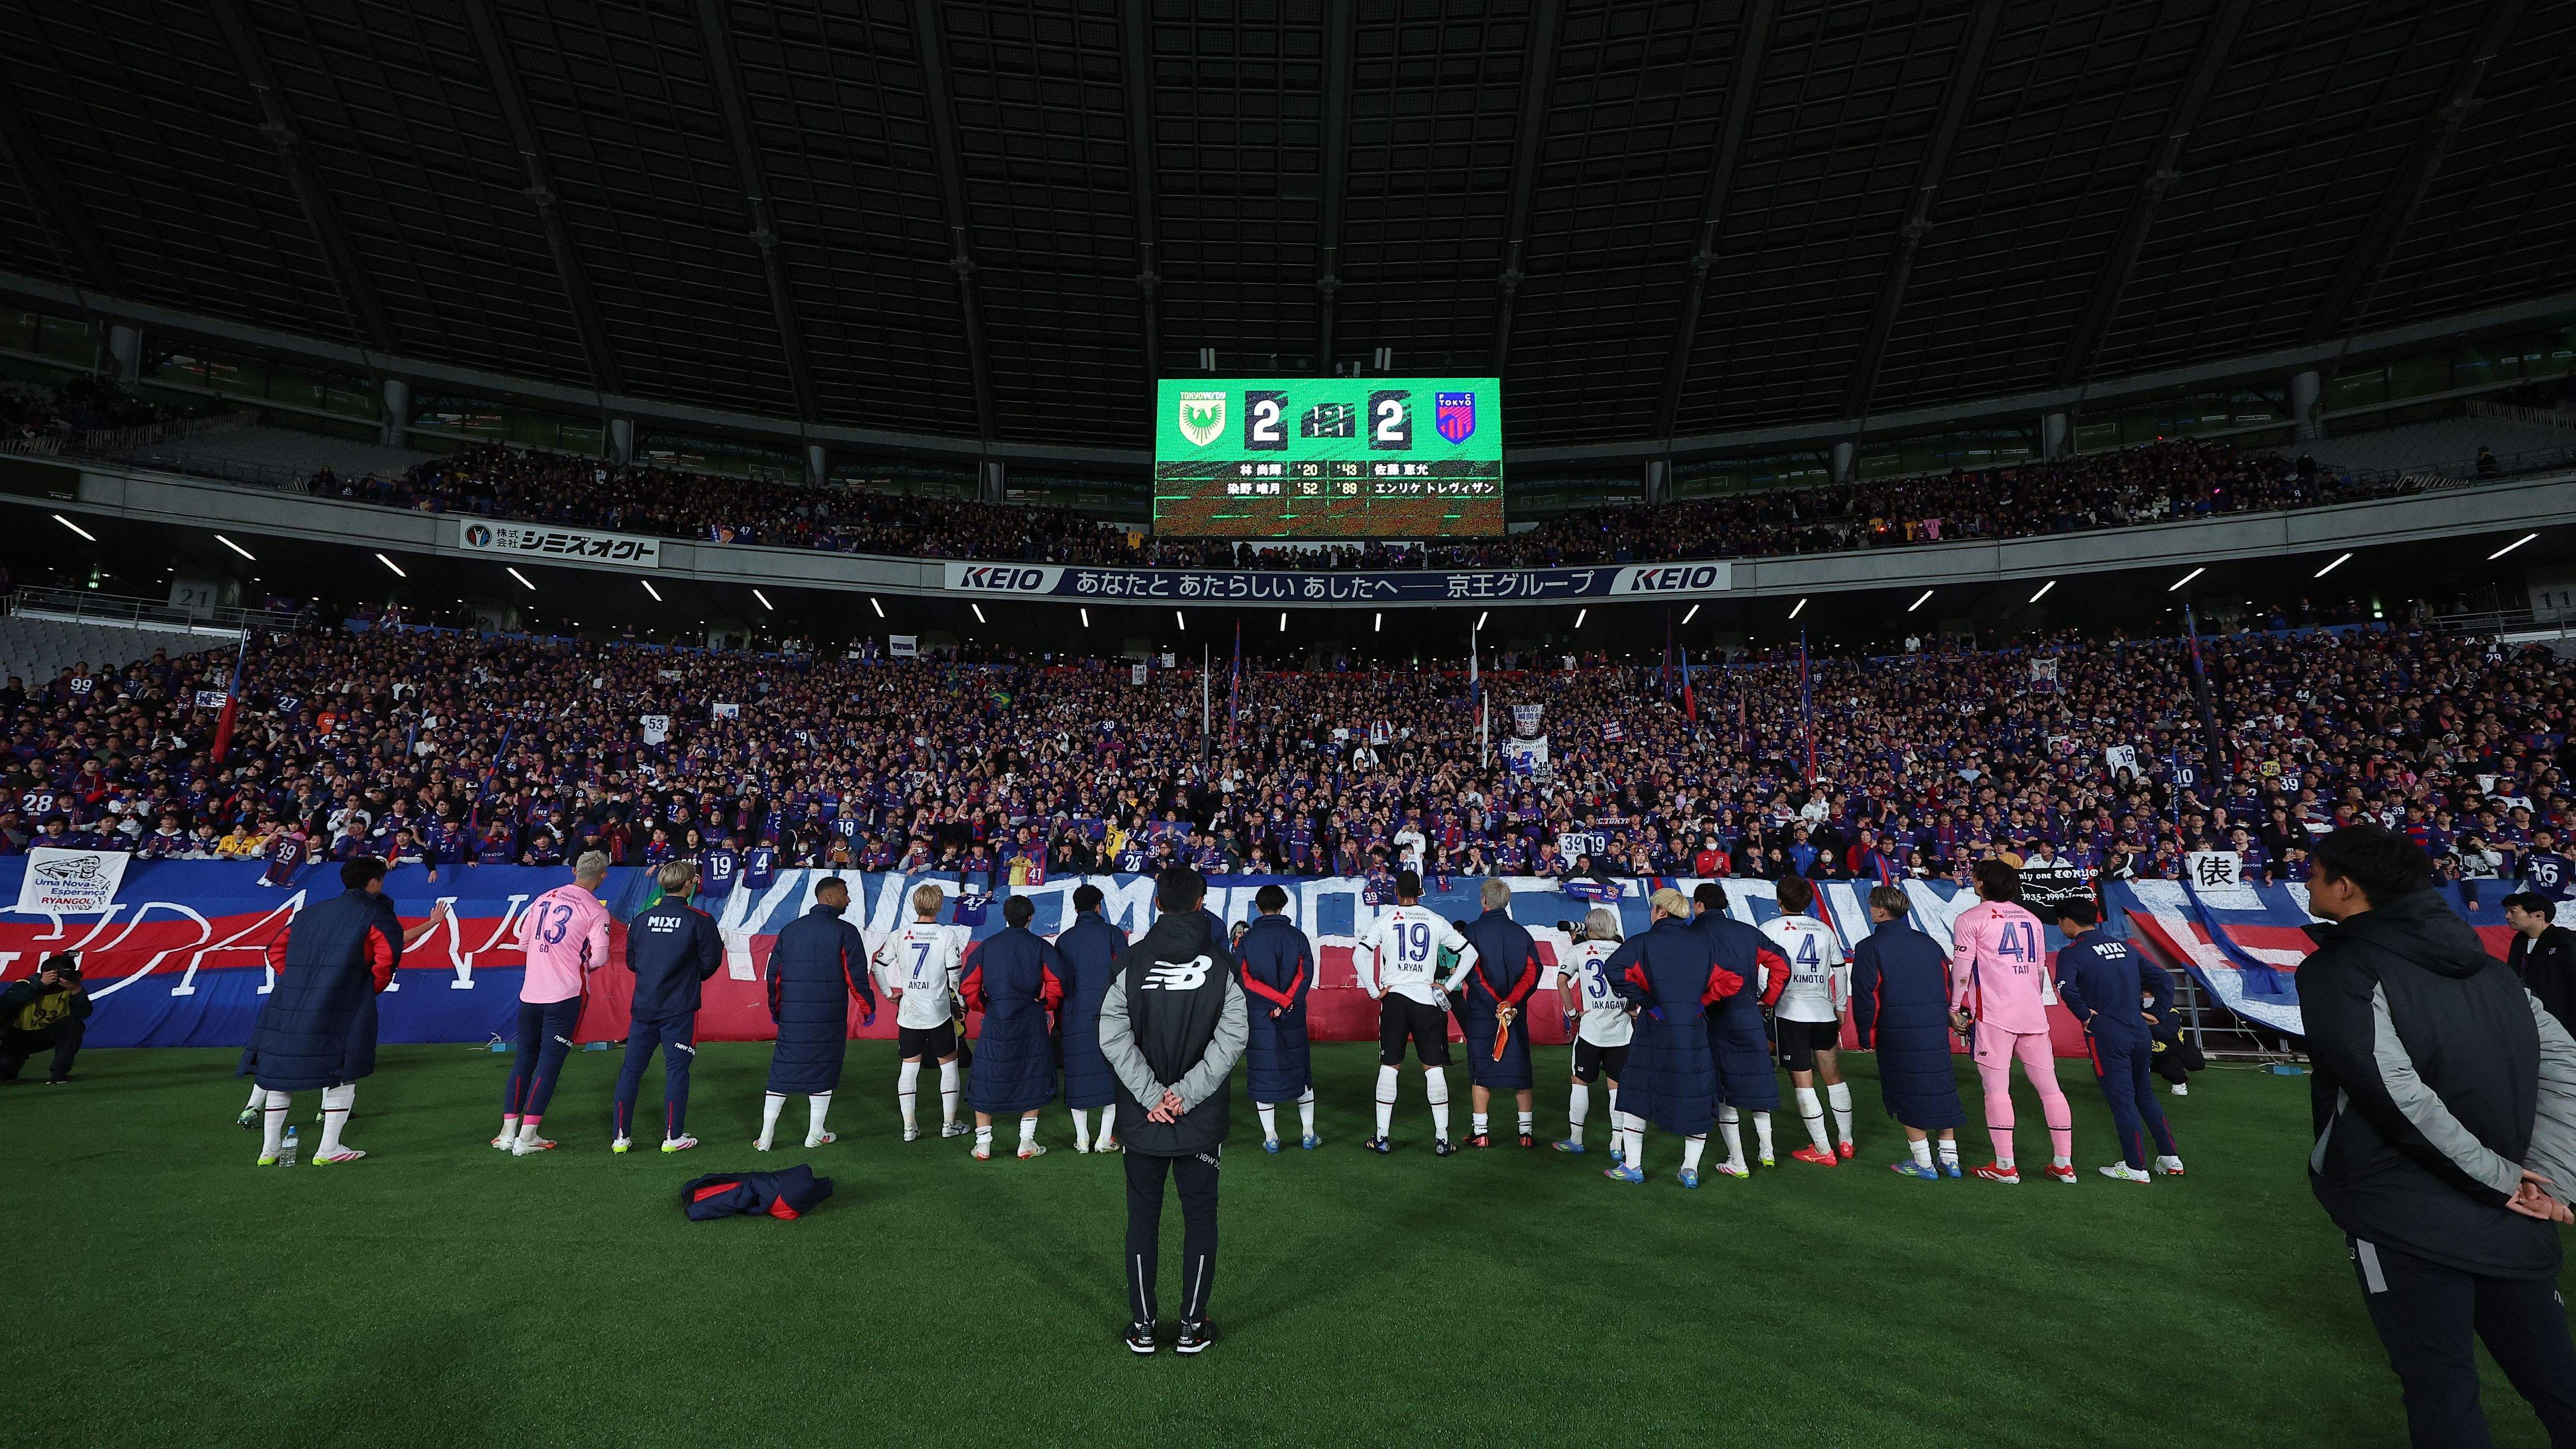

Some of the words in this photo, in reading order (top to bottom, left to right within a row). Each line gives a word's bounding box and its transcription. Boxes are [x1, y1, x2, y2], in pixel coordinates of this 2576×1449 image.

[1254, 399, 1280, 441] 2
[1378, 399, 1403, 441] 2
[1240, 464, 1252, 476] 林
[1257, 464, 1281, 476] 尚輝
[1374, 464, 1400, 476] 佐藤
[1404, 464, 1429, 476] 恵允
[1227, 482, 1252, 495] 染野
[1257, 482, 1280, 495] 唯月
[1375, 483, 1422, 495] エンリケ
[1426, 482, 1494, 495] トレヴィザン
[496, 528, 519, 538] 株式
[740, 526, 750, 535] 47
[496, 539, 518, 549] 会社
[520, 531, 655, 561] シミズオクト
[960, 567, 1043, 590] KEIO
[1076, 572, 1169, 595] あなたと
[1178, 574, 1295, 598] あたらしい
[1303, 576, 1399, 599] あしたへ
[1447, 570, 1595, 598] 京王グループ
[1631, 566, 1718, 590] KEIO
[180, 588, 207, 606] 21
[2540, 590, 2570, 609] 11
[69, 677, 93, 691] 99
[1813, 673, 1822, 682] 16
[2295, 689, 2310, 699] 44
[277, 696, 298, 708] 27
[648, 718, 664, 730] 53
[1103, 720, 1115, 730] 30
[1602, 721, 1620, 729] START
[1604, 731, 1624, 740] ENGINE
[1501, 743, 1511, 755] 16
[2119, 749, 2134, 763] 16
[1538, 761, 1548, 770] 44
[2176, 768, 2194, 784] 10
[2279, 777, 2299, 791] 39
[22, 794, 54, 812] 28
[672, 805, 678, 814] 7
[2391, 806, 2405, 815] 39
[838, 820, 855, 837] 18
[1564, 835, 1582, 851] 39
[1588, 836, 1606, 852] 19
[277, 842, 298, 860] 39
[1149, 845, 1160, 856] 39
[709, 856, 732, 876] 19
[756, 852, 768, 870] 4
[1124, 854, 1143, 872] 28
[1029, 868, 1042, 880] 41
[2018, 871, 2033, 882] nly
[2054, 868, 2099, 880] TOKYO
[2197, 855, 2235, 887] 俵
[2531, 861, 2559, 884] 16
[51, 887, 106, 896] Esperança
[1364, 891, 1378, 901] 39
[41, 896, 93, 904] RYANGOL
[963, 897, 987, 907] 47
[535, 901, 573, 944] 13
[647, 916, 681, 928] MIXI
[538, 944, 549, 953] GO
[1393, 923, 1430, 962] 19
[1998, 921, 2035, 963] 41
[1796, 934, 1820, 972] 4
[2092, 942, 2127, 956] MIXI
[912, 943, 930, 980] 7
[908, 981, 929, 989] ANZAI
[1585, 958, 1610, 999] 3
[1794, 974, 1824, 984] KIMOTO
[554, 1035, 567, 1044] new
[674, 1042, 687, 1051] new
